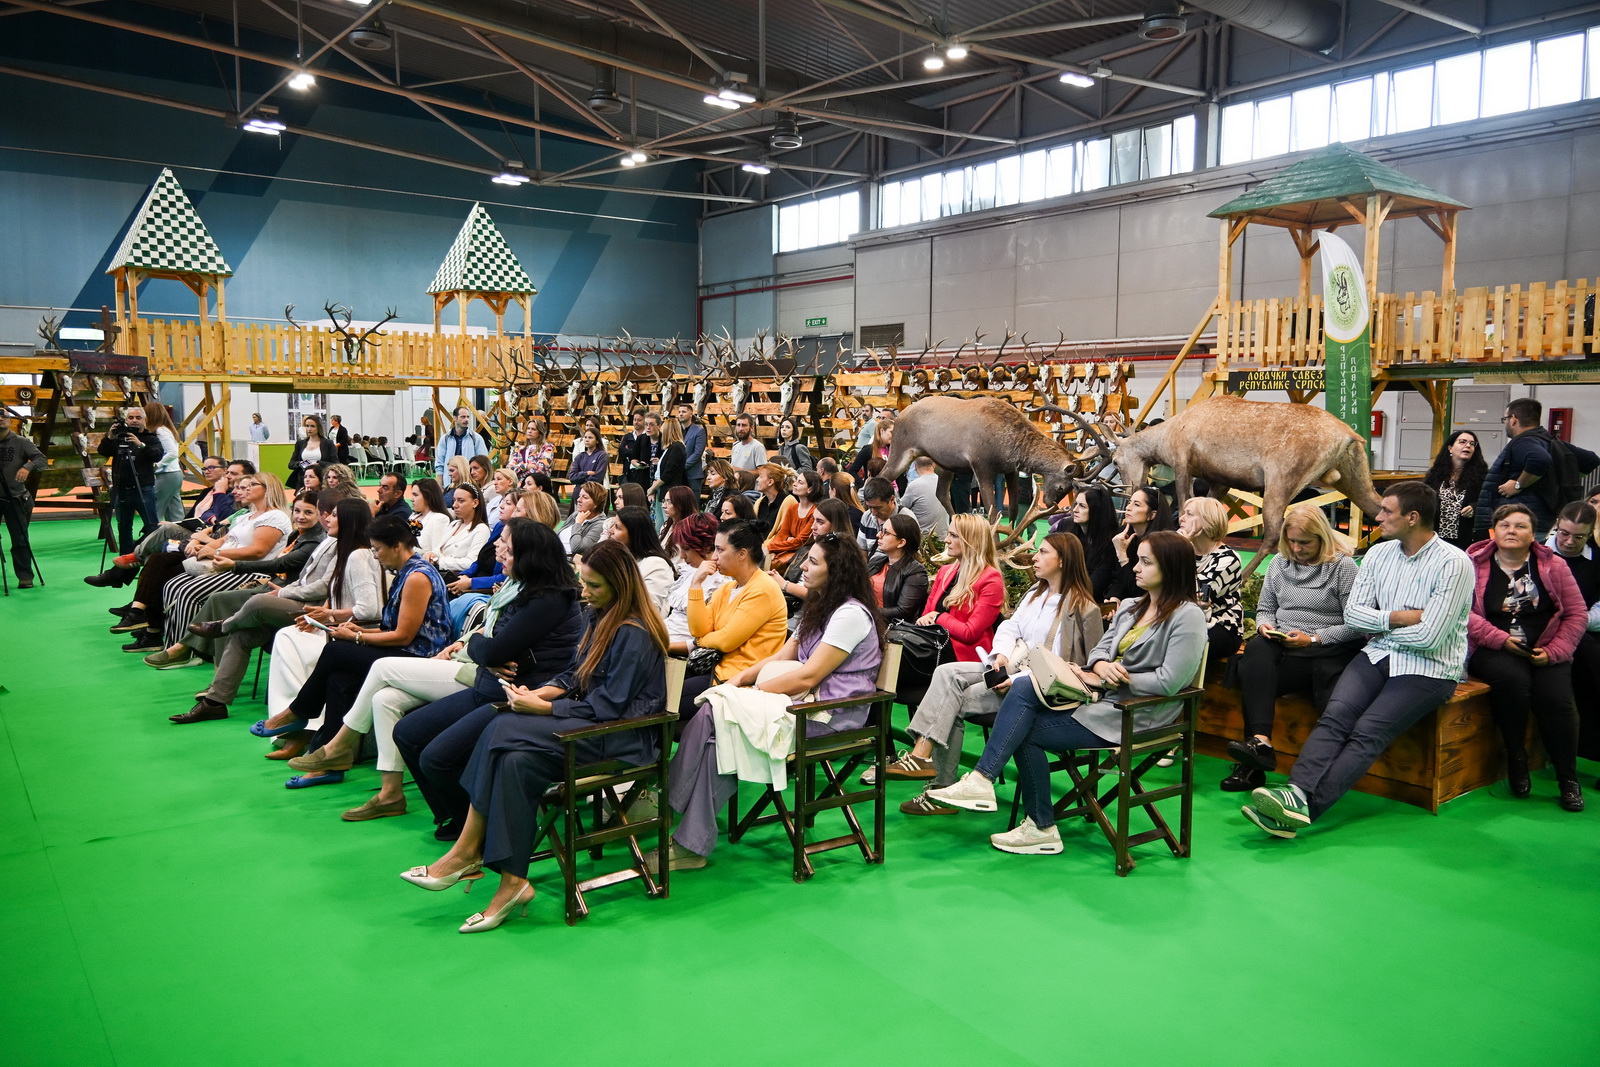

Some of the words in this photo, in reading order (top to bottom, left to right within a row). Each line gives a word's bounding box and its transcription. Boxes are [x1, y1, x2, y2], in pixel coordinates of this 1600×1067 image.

[1248, 371, 1287, 380] ЛОВАЧКИ
[1292, 370, 1323, 379] САВЕЗ
[1239, 380, 1290, 390] РЕПУБЛИКЕ
[1295, 380, 1325, 389] СРПСК
